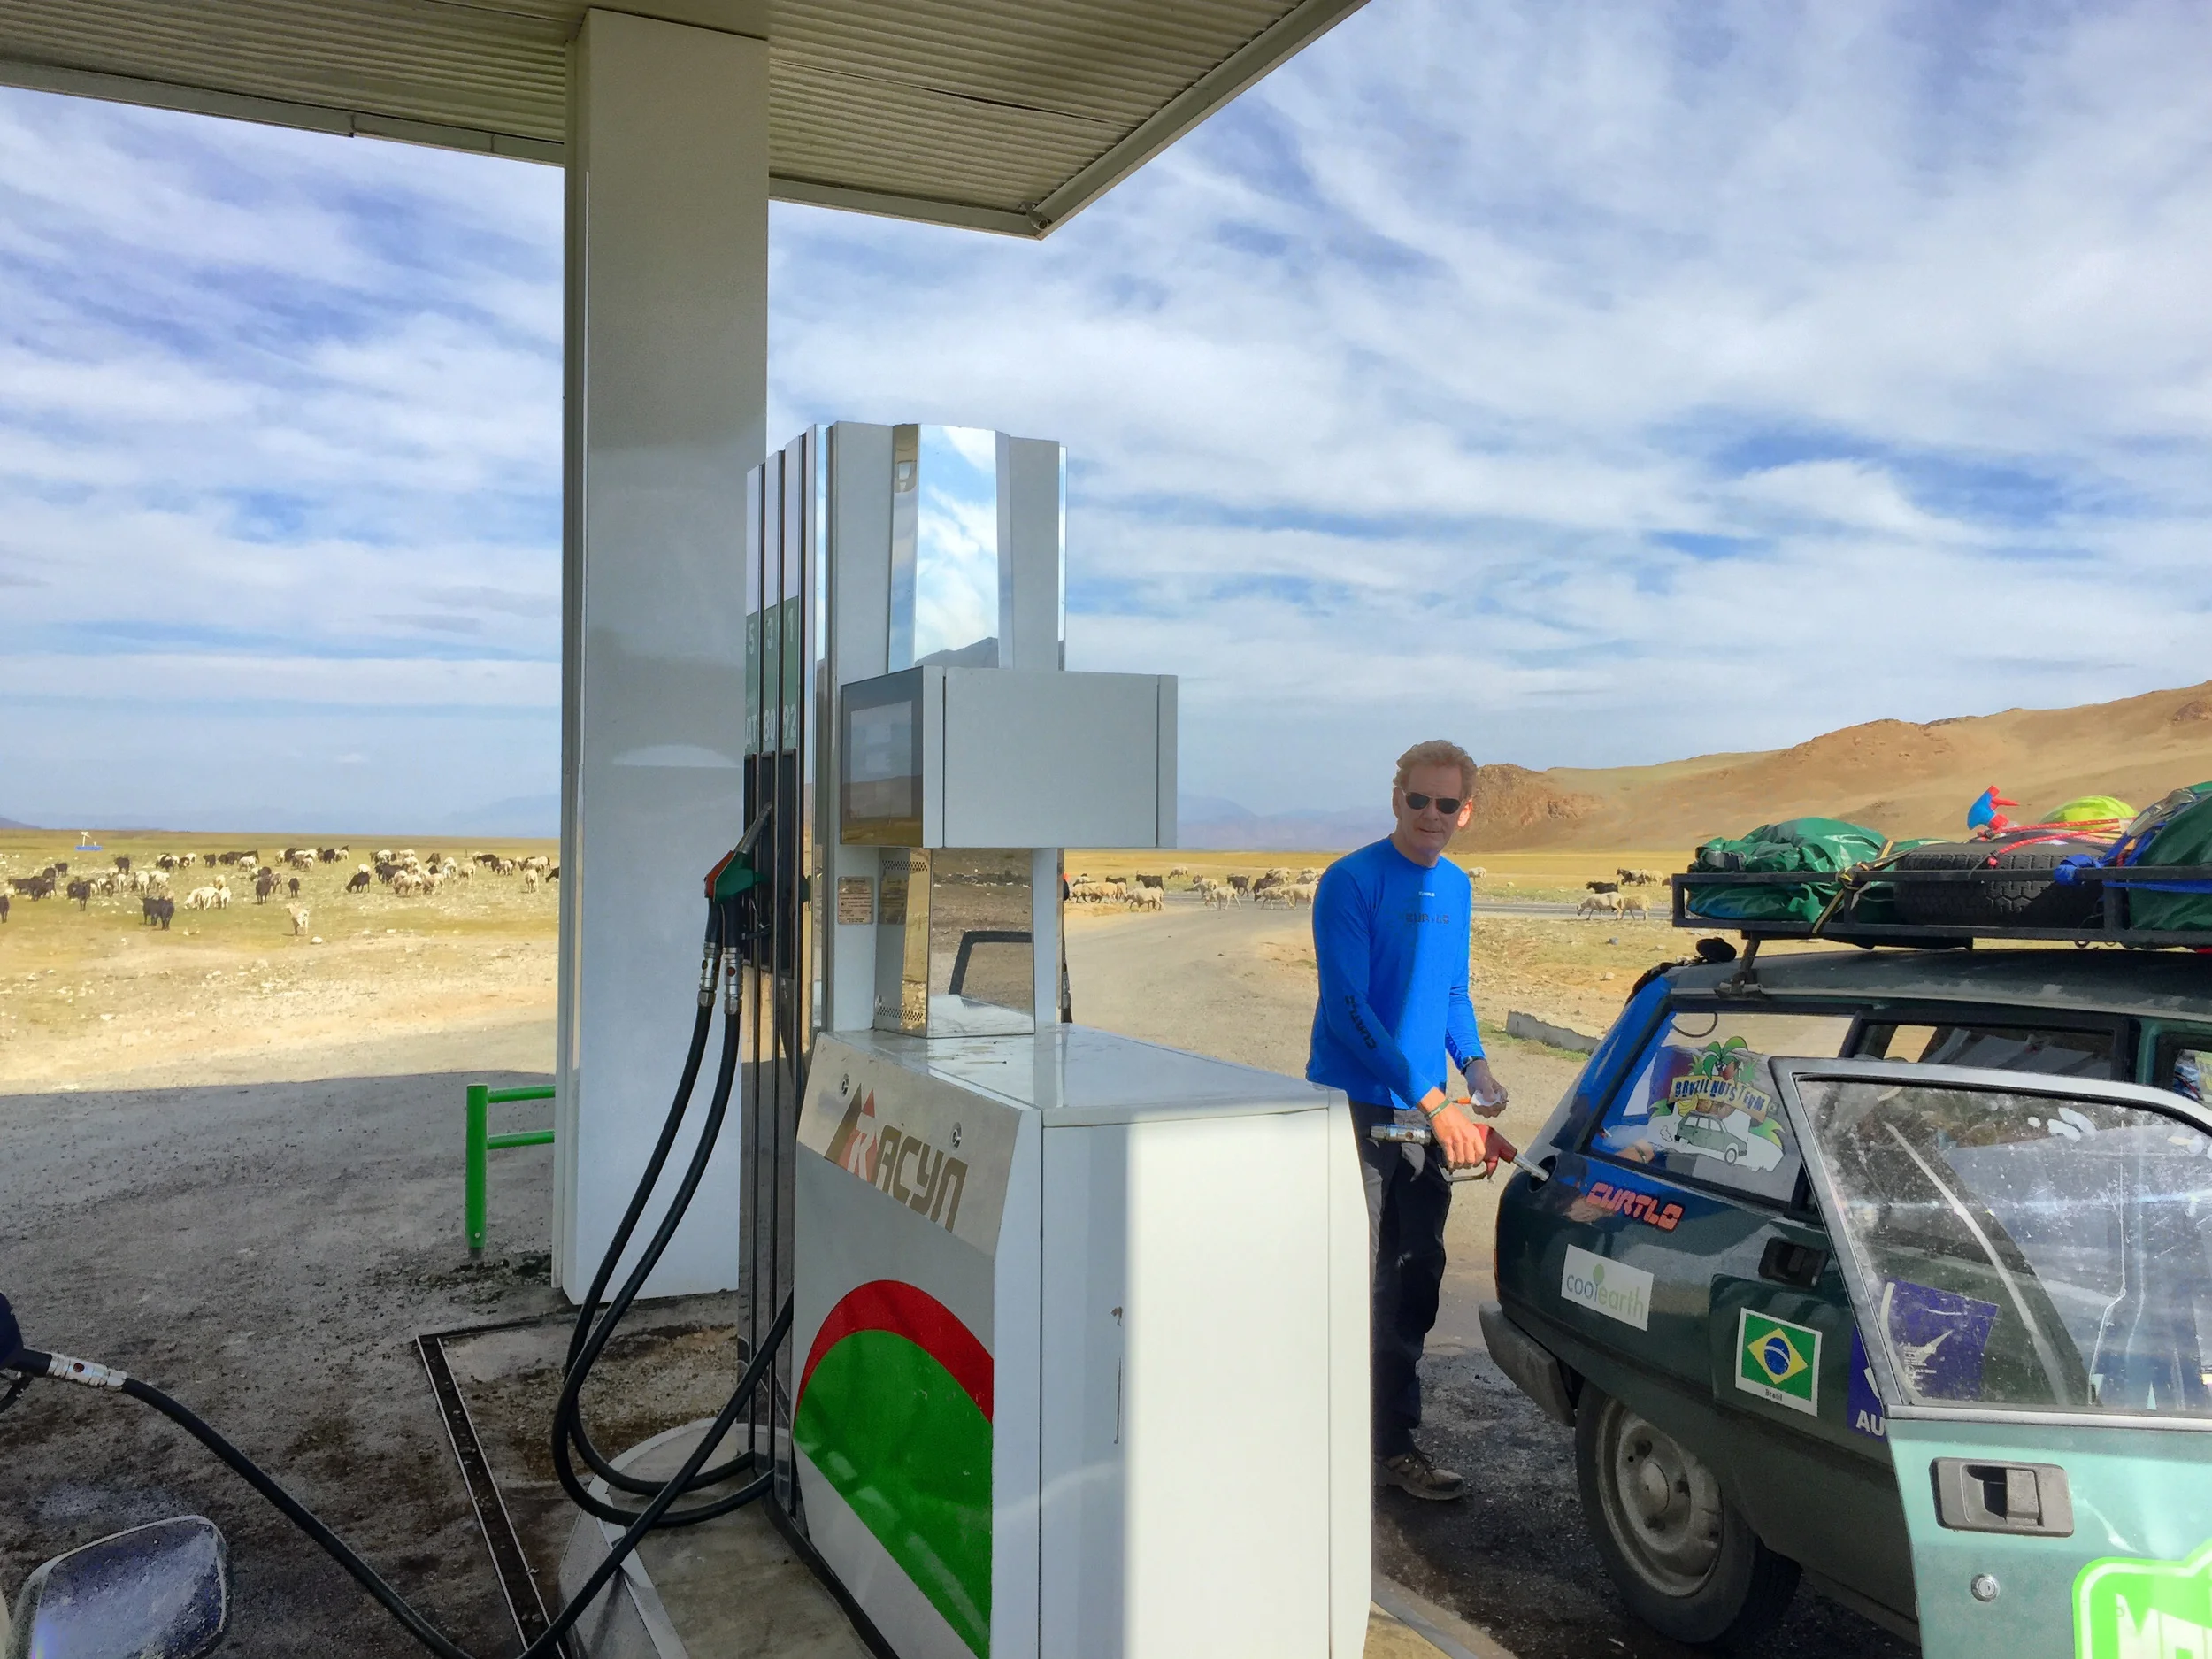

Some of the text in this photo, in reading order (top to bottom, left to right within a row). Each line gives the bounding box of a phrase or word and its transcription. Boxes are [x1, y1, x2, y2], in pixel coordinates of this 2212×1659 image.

[766, 618, 773, 649] 3
[787, 608, 794, 642] 1
[764, 709, 776, 741] 80
[783, 704, 797, 739] 92
[1709, 1079, 1738, 1102] NUTS
[1586, 1181, 1684, 1231] CURTLO
